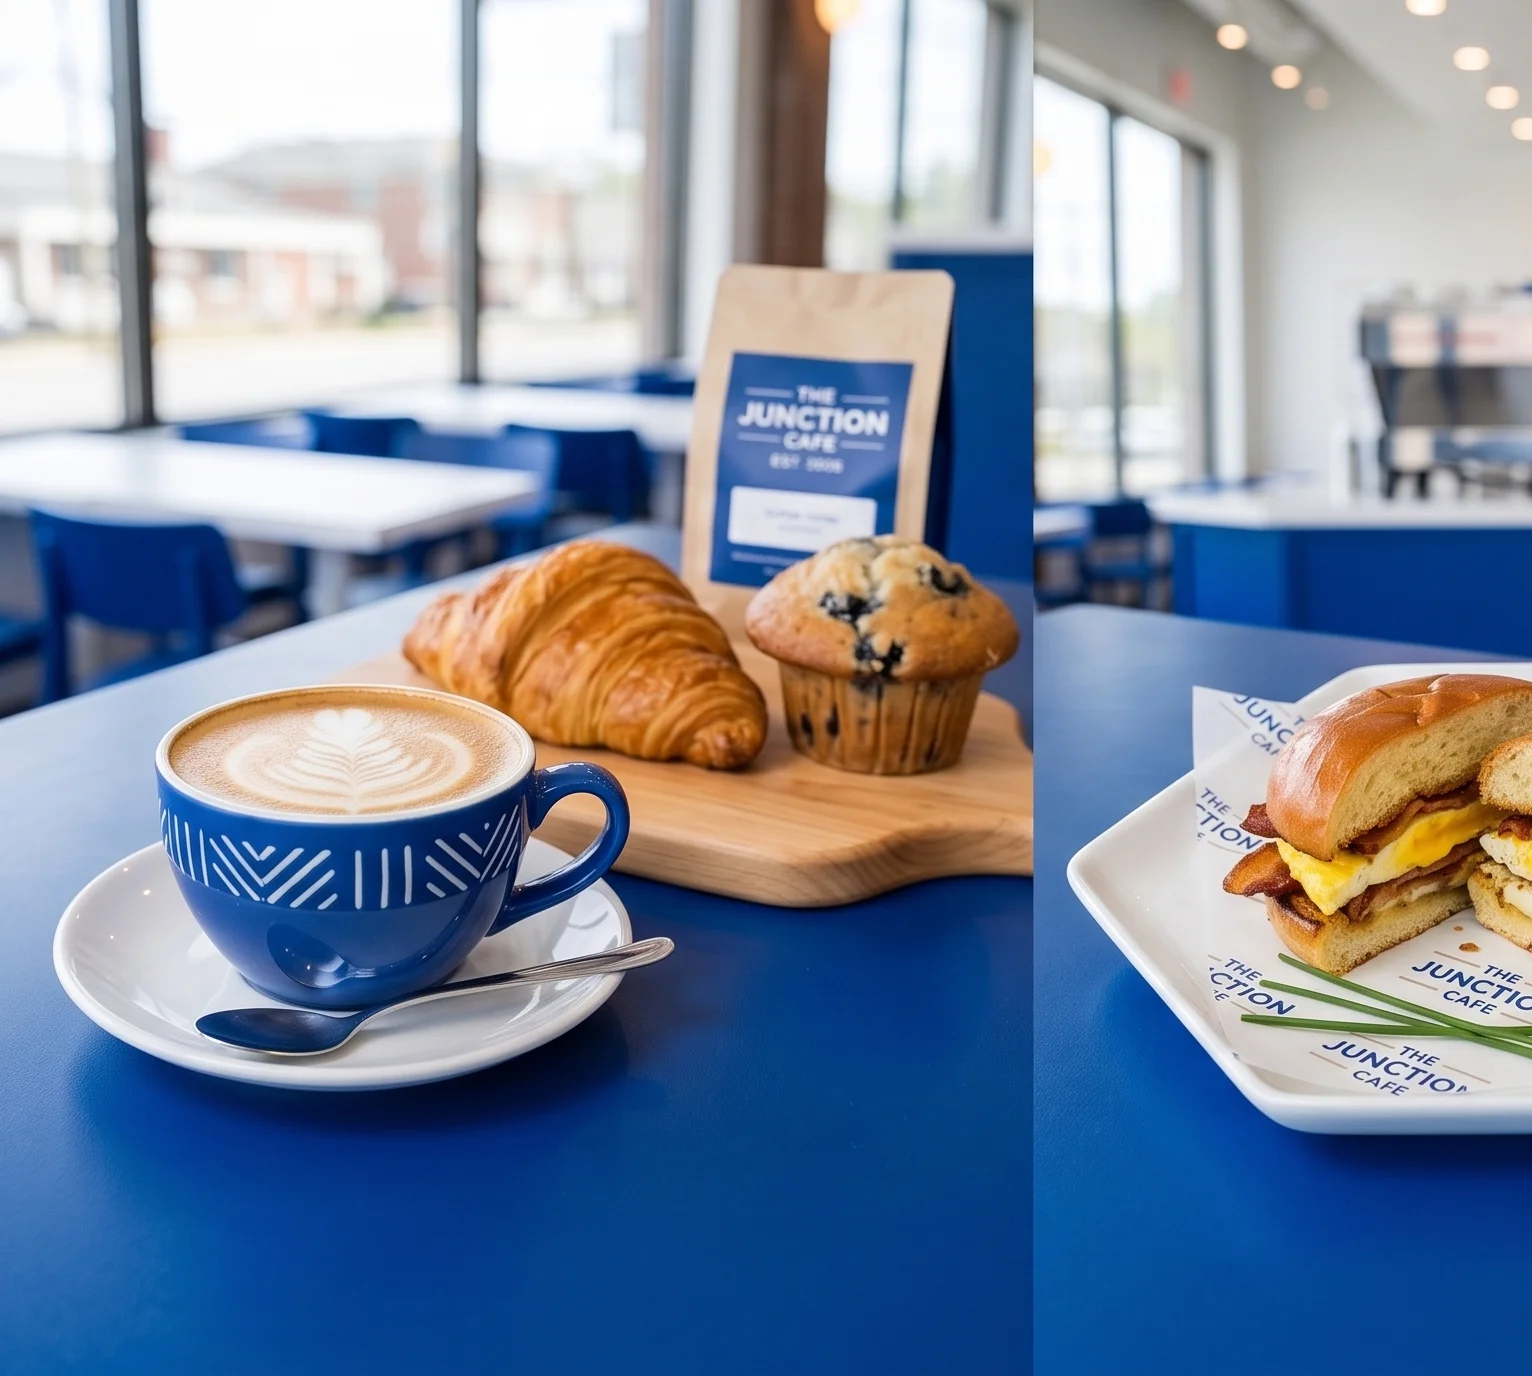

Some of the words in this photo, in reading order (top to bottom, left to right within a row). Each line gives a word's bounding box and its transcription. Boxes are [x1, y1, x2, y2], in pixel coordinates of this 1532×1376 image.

[797, 385, 837, 405] THE
[737, 401, 890, 436] JUNCTION
[783, 432, 839, 453] CAFE
[1200, 788, 1232, 816] THE
[1196, 803, 1263, 850] TION
[1224, 958, 1263, 981] THE
[1483, 964, 1524, 985] THE
[1209, 967, 1296, 1016] CTION
[1443, 990, 1498, 1015] CAFE
[1399, 1045, 1441, 1067] THE
[1353, 1070, 1410, 1096] CAFE
